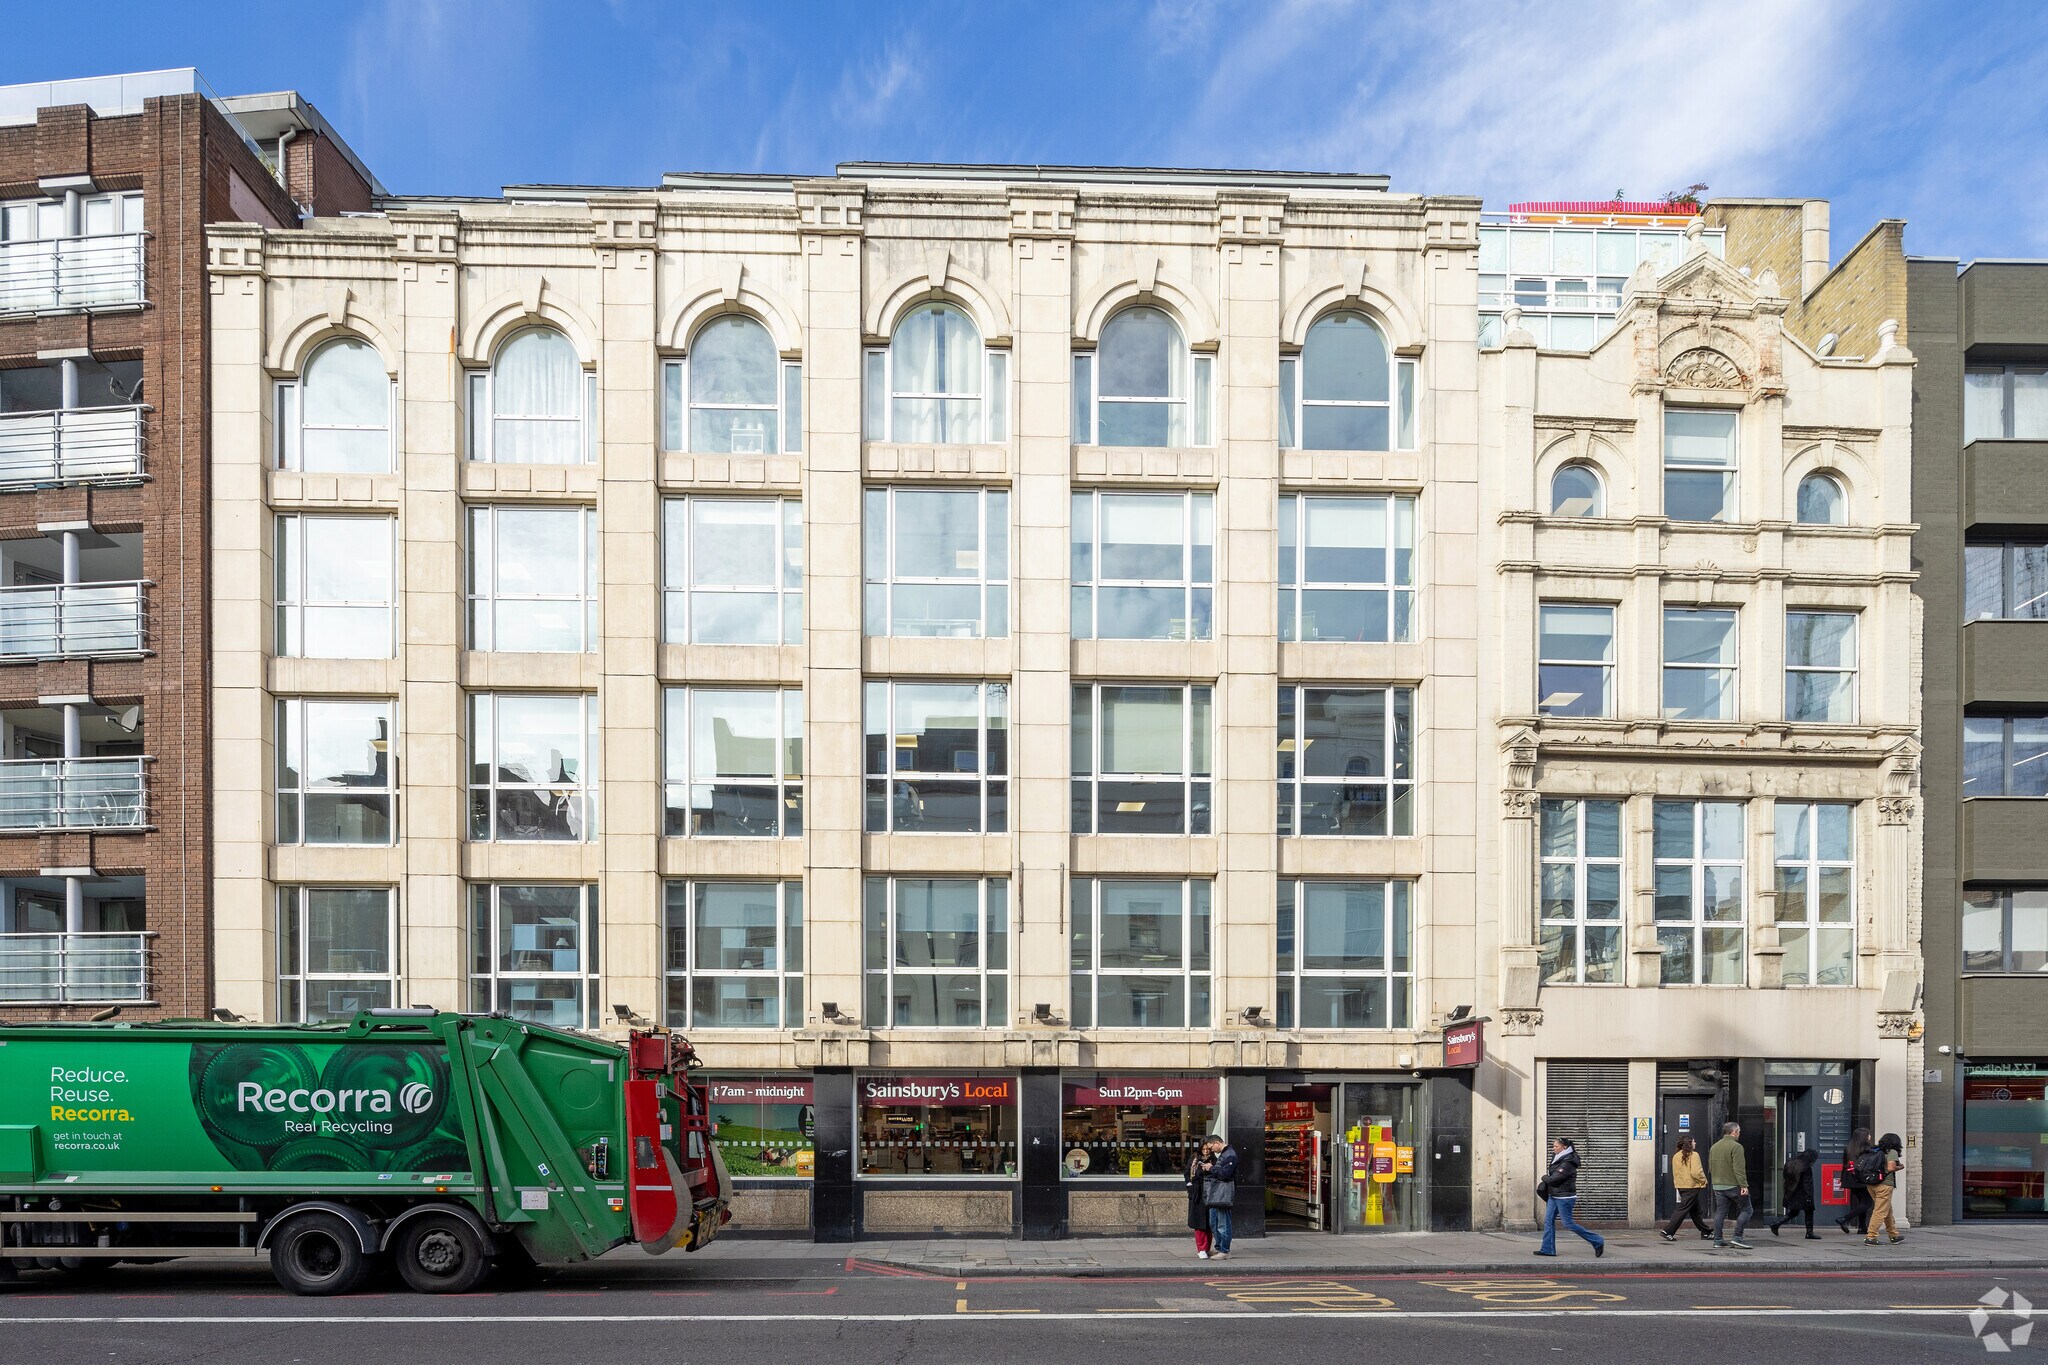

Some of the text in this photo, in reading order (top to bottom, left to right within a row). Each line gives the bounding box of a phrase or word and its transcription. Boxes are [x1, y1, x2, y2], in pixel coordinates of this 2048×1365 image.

[1447, 1031, 1476, 1045] Sainsbury's
[1447, 1044, 1462, 1055] Local
[51, 1066, 129, 1083] Reduce.
[50, 1086, 114, 1102] Reuse.
[238, 1082, 392, 1113] Recorra
[720, 1086, 745, 1097] 7am
[755, 1086, 805, 1099] midnight
[866, 1082, 1009, 1101] Sainsbury's Local
[1099, 1086, 1122, 1098] Sun
[50, 1106, 135, 1121] Recorra.
[284, 1120, 393, 1135] Real Recycling
[53, 1132, 123, 1142] get in touch at
[54, 1142, 120, 1150] recorra.co.uk
[1204, 1280, 1396, 1308] STOP
[1418, 1279, 1627, 1303] BUS
